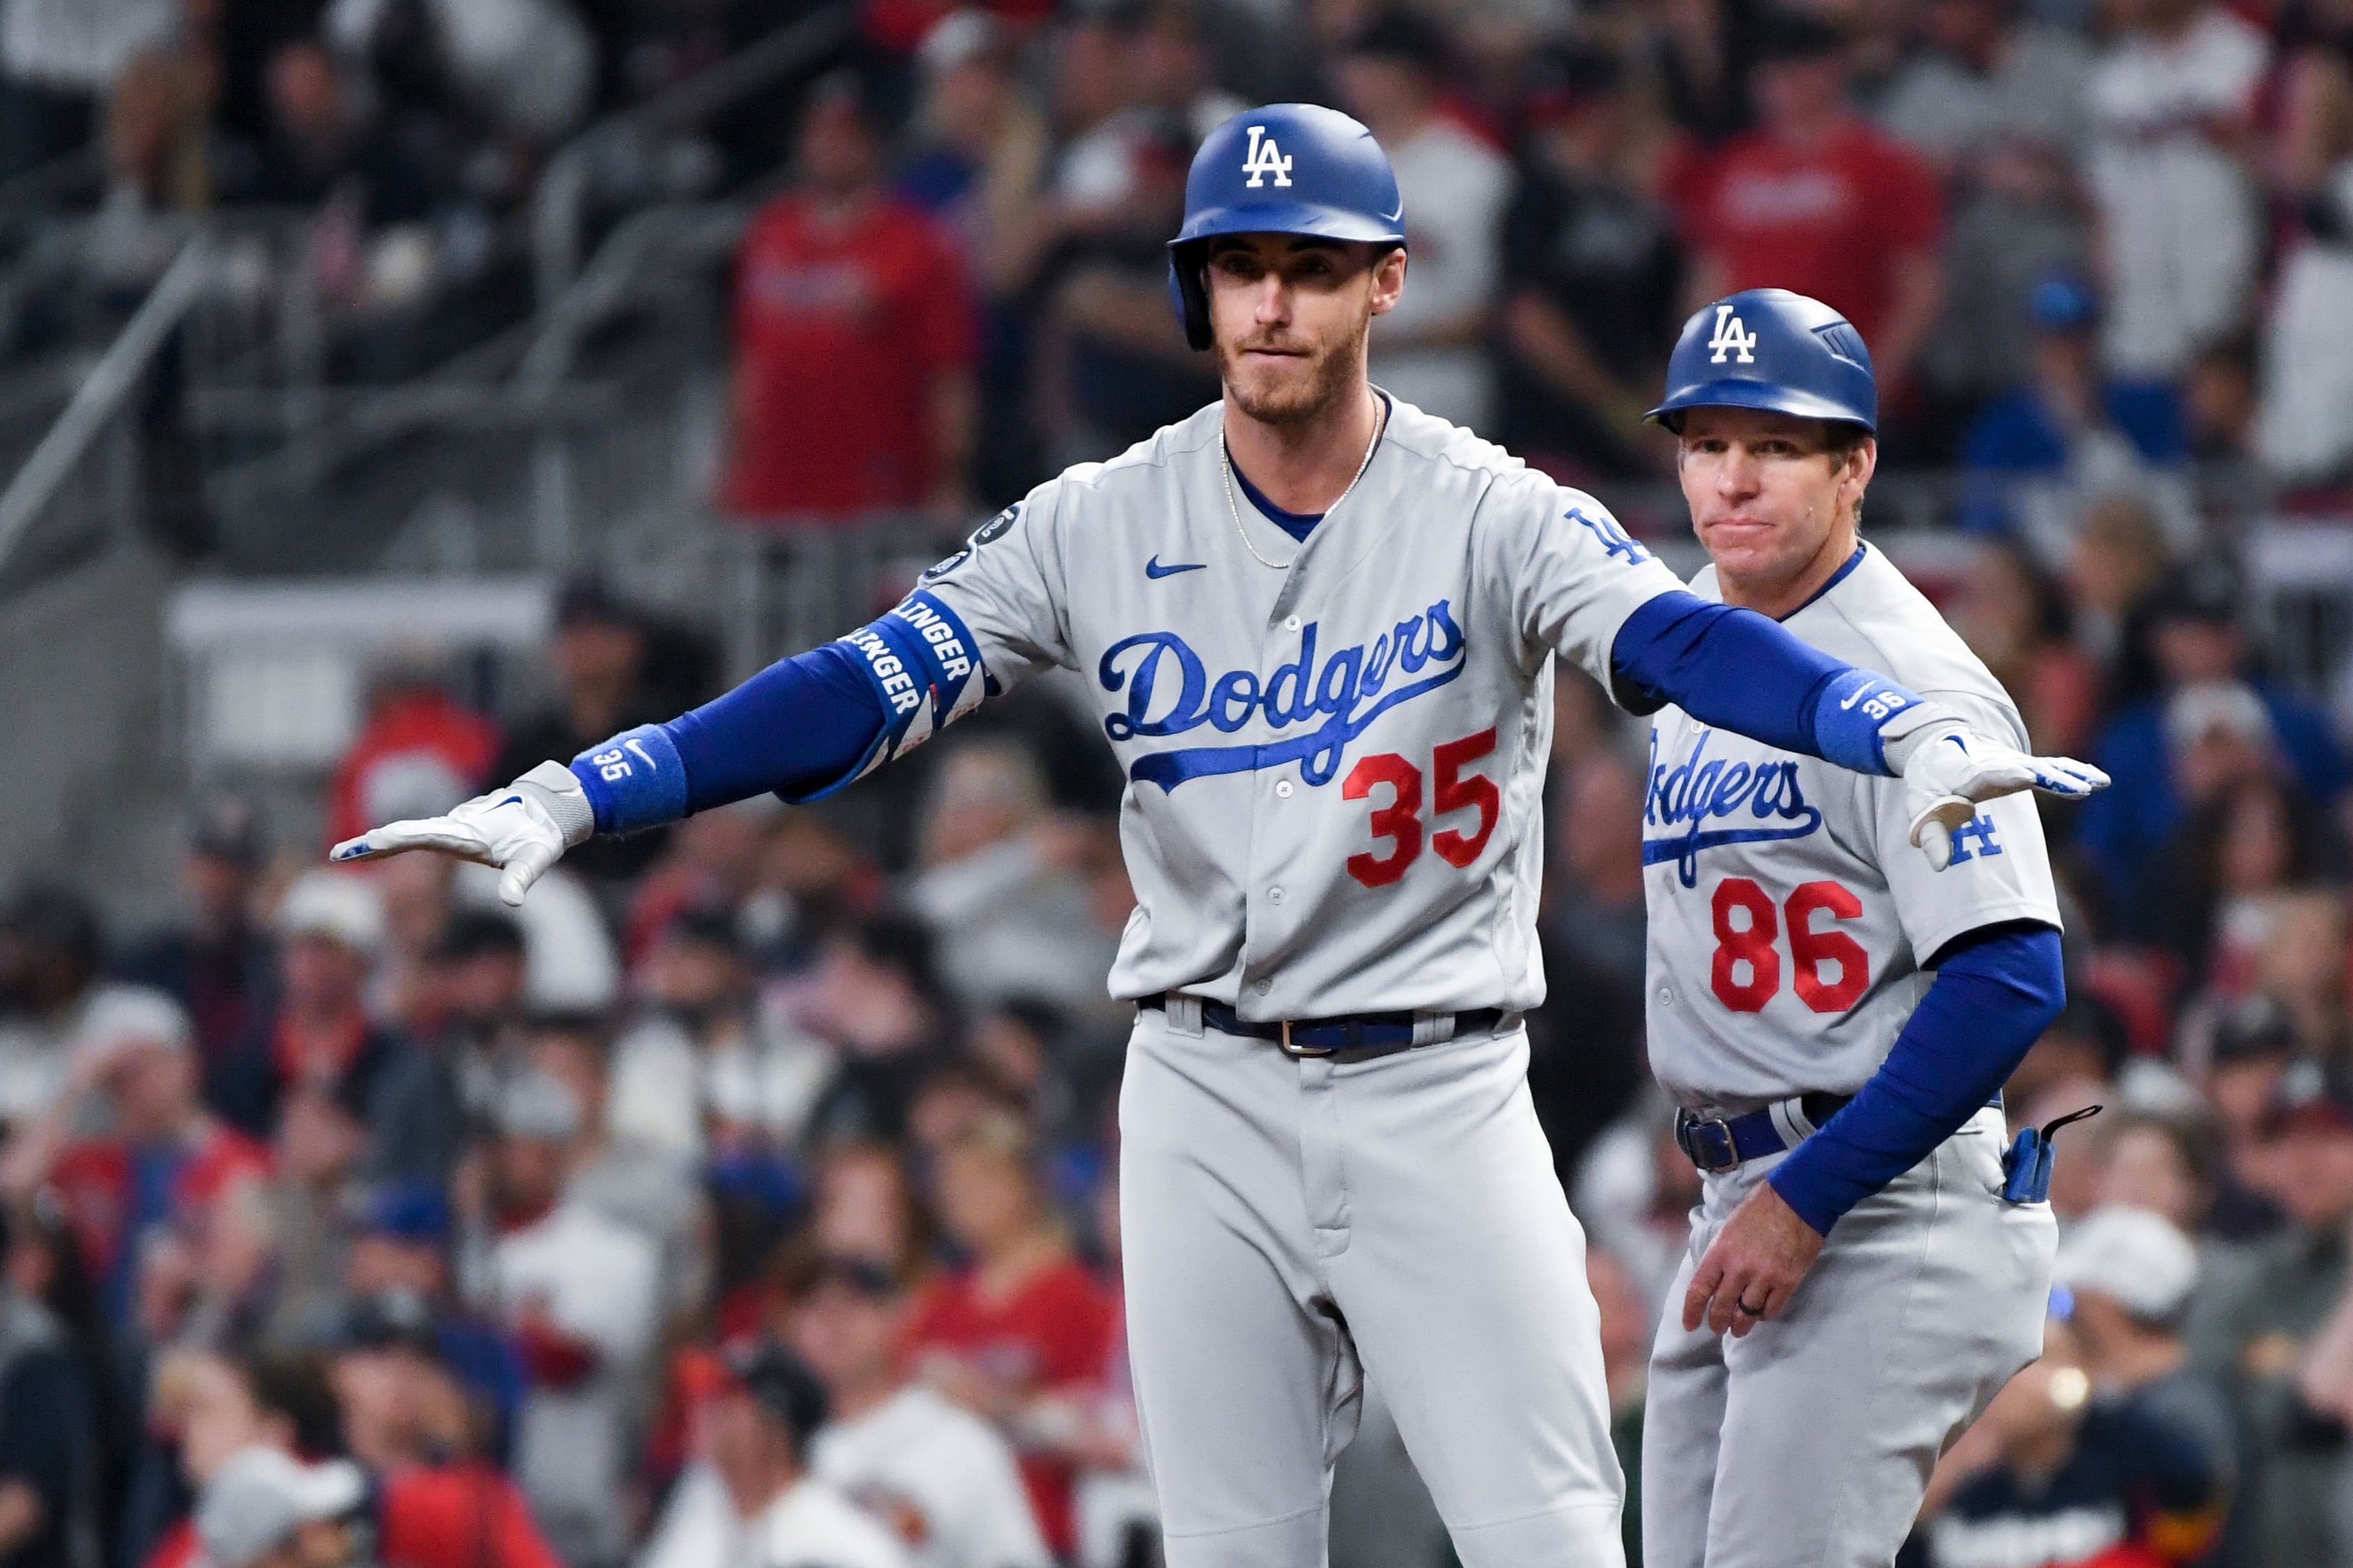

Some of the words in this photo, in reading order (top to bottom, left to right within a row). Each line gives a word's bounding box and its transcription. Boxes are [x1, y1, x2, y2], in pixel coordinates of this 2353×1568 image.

[1242, 126, 1292, 187] LA
[1708, 305, 1756, 363] LA
[1099, 599, 1466, 787] Dodgers
[1862, 691, 1907, 720] 35
[593, 749, 633, 781] 35
[1342, 726, 1499, 888] 35
[1711, 878, 1870, 1013] 86
